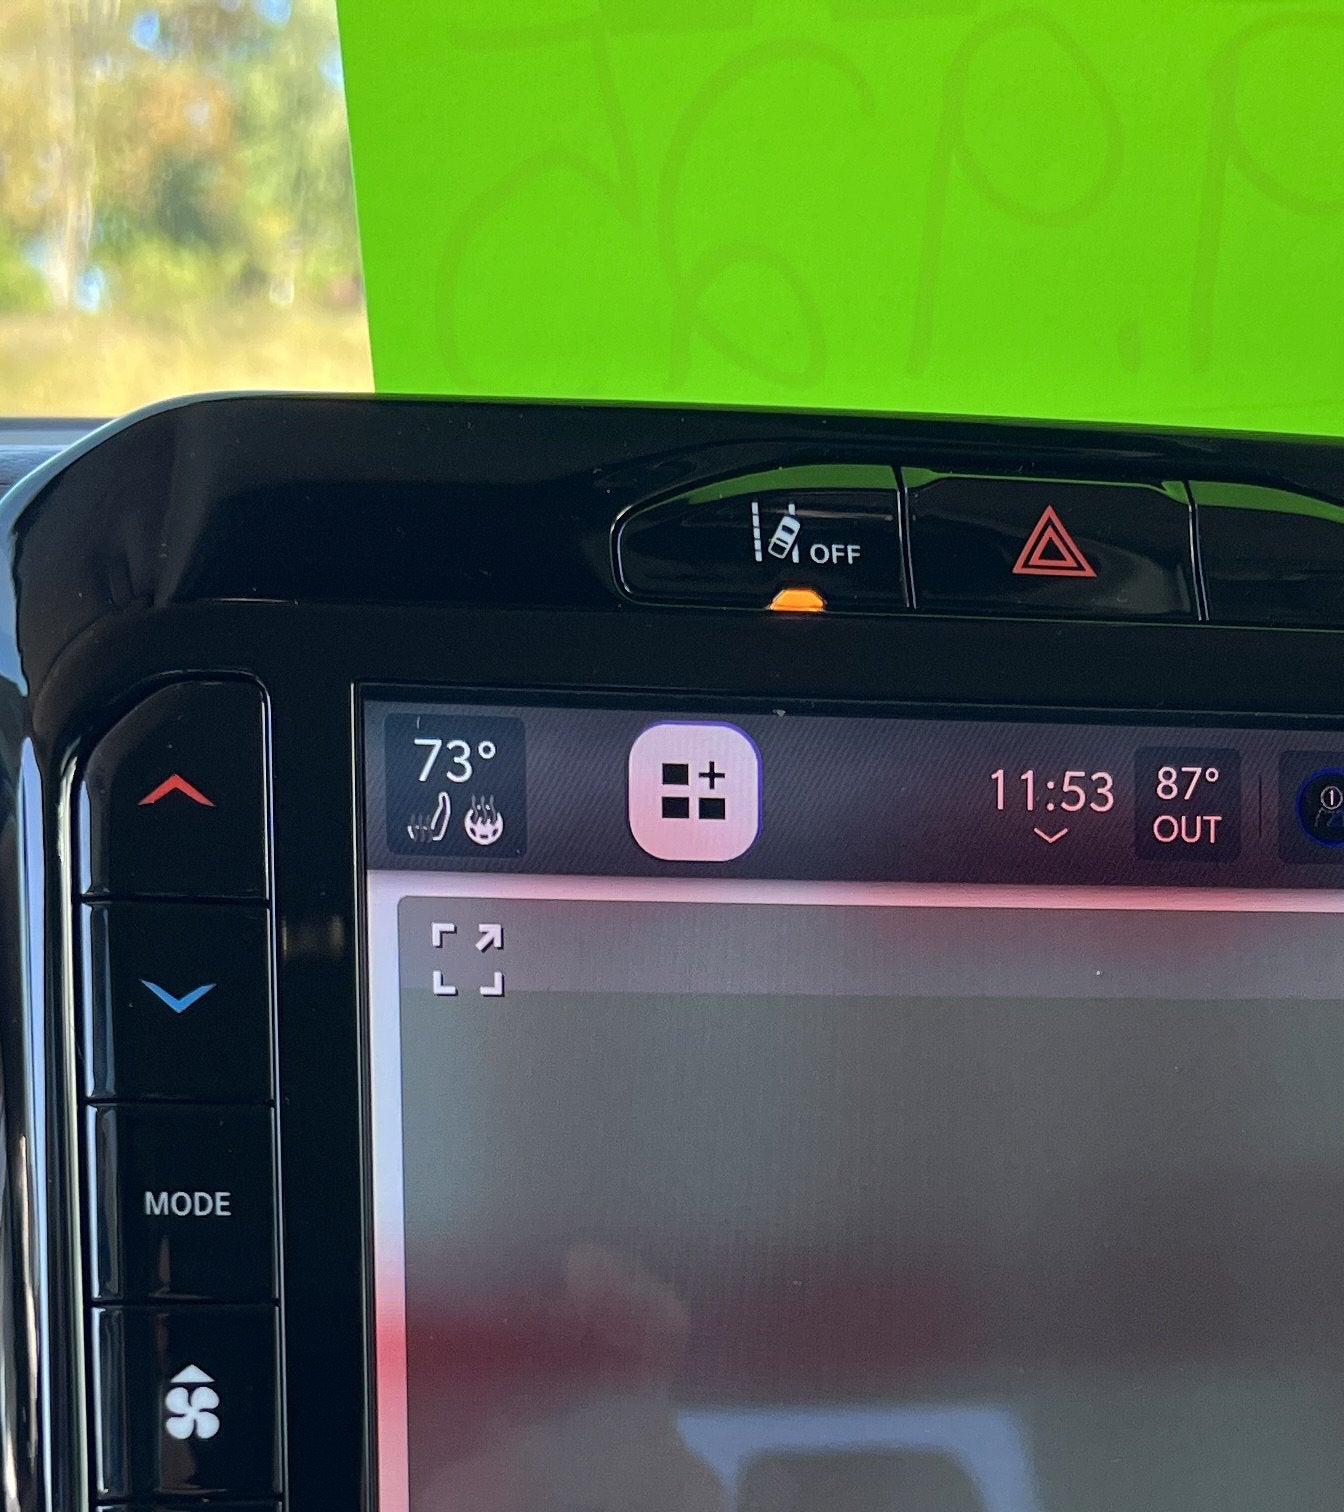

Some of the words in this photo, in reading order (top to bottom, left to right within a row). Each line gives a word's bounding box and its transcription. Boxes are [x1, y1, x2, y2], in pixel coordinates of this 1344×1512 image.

[810, 543, 861, 565] OFF
[413, 737, 497, 784] 73°
[991, 769, 1115, 813] 11:53
[1156, 765, 1219, 801] 87°
[1153, 814, 1222, 845] OUT
[144, 1190, 232, 1217] MODE
